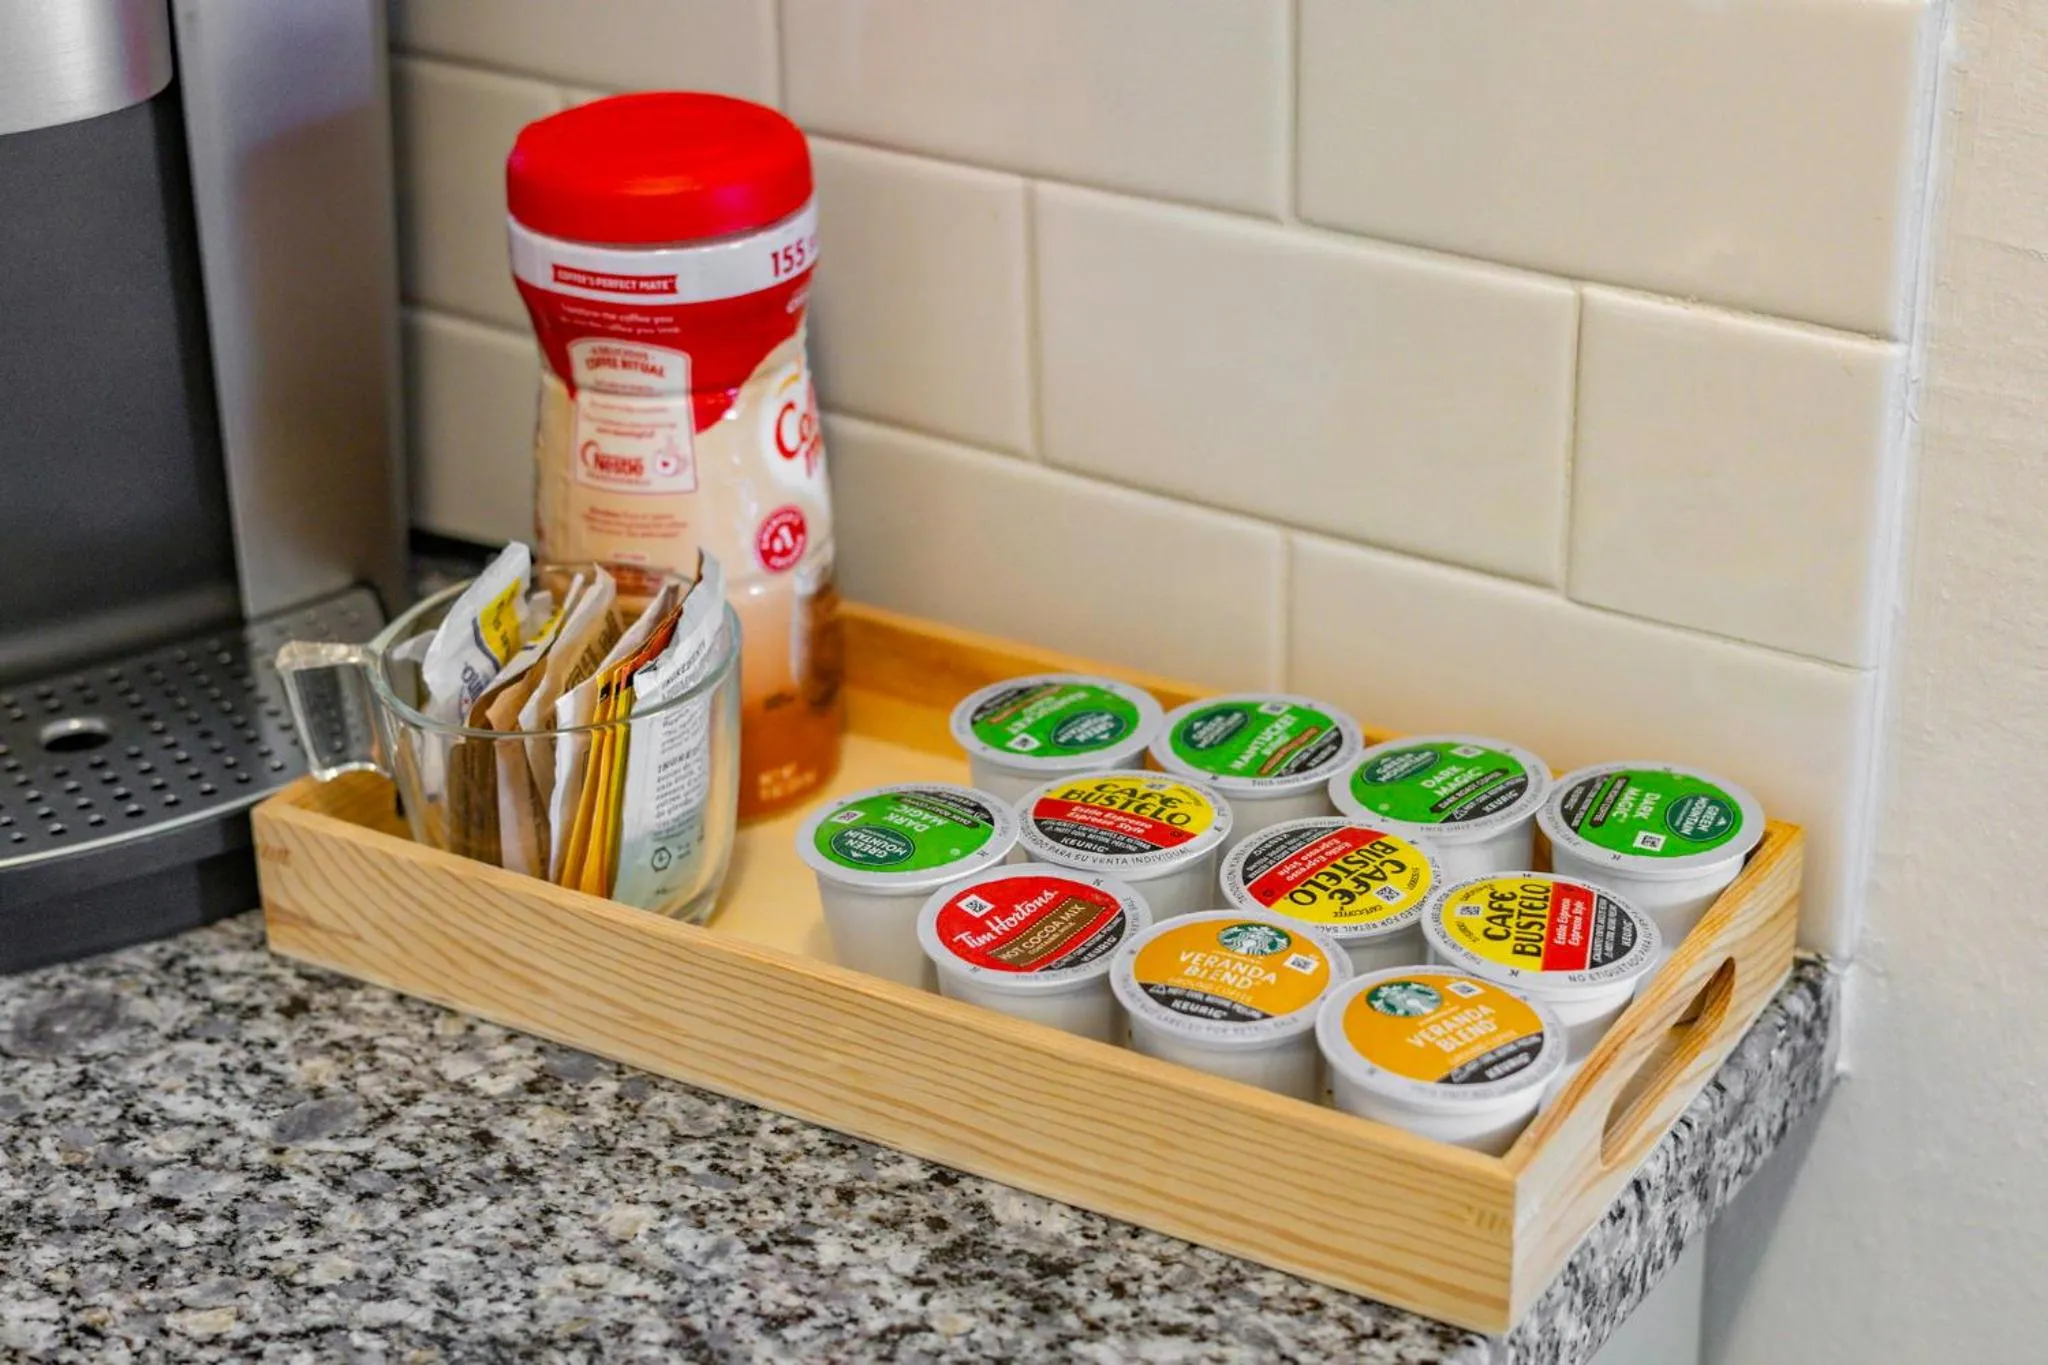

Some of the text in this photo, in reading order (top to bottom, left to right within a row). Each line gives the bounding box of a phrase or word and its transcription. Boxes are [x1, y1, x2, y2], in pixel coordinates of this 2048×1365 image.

[770, 237, 805, 278] 155
[886, 812, 931, 833] DARK
[1059, 788, 1192, 827] BUSTELO
[1066, 811, 1146, 834] Espresso Style
[843, 828, 908, 856] MOUNTAIN
[845, 838, 888, 859] GREEN
[1059, 836, 1110, 853] KEURIG
[1074, 853, 1090, 862] SU
[1287, 835, 1399, 906] BUSTELO
[951, 888, 1058, 949] Tim Hortons
[1022, 917, 1065, 950] COCOA
[1060, 903, 1087, 923] MIX
[1512, 883, 1551, 957] BUSTELO
[1178, 950, 1278, 985] VERANDA
[1183, 964, 1256, 989] BLEND
[1168, 999, 1225, 1019] KEURIG
[1405, 1004, 1497, 1048] VERANDA
[1435, 1019, 1498, 1053] BLEND
